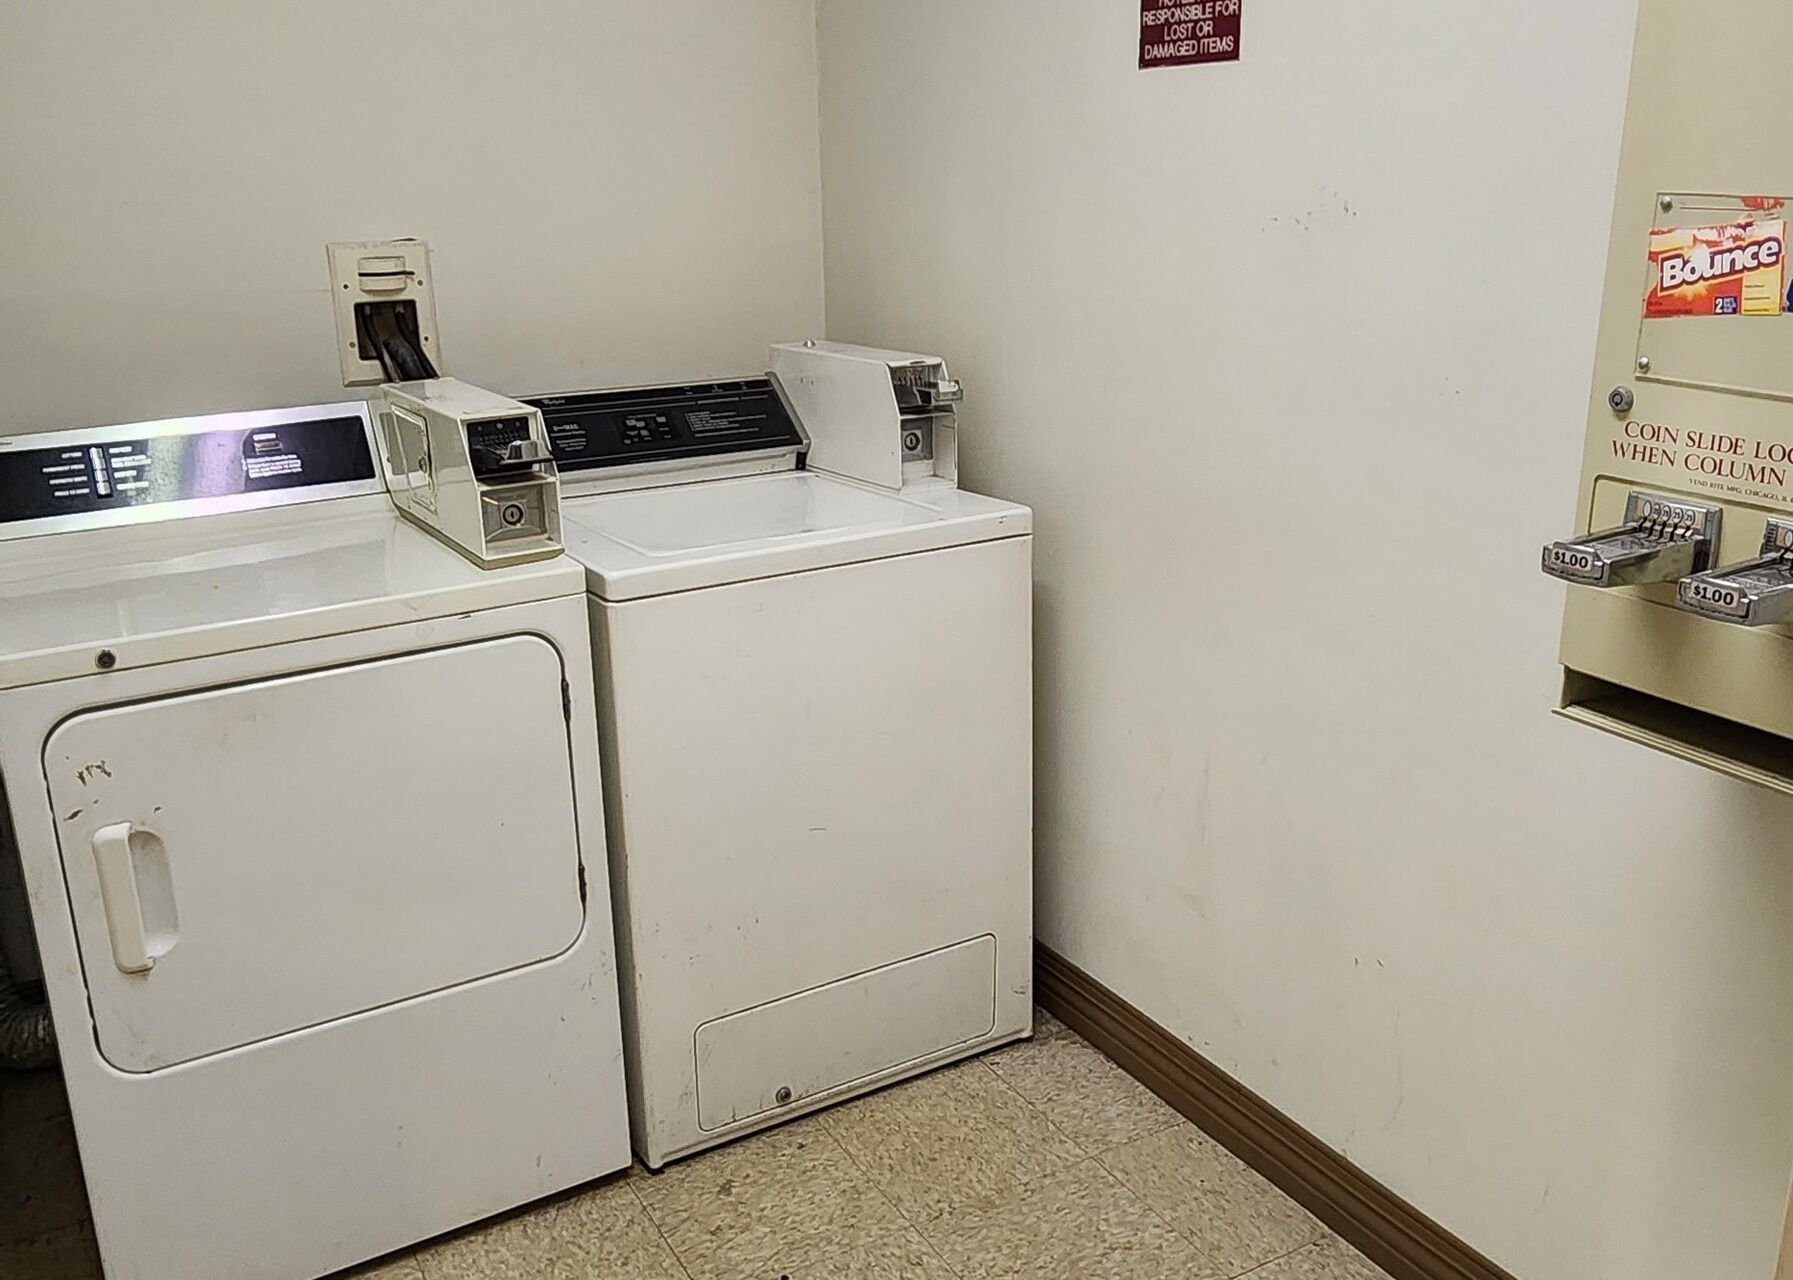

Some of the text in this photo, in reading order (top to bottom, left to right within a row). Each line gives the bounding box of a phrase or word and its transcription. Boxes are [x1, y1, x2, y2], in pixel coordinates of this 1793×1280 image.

[1142, 0, 1239, 26] RESPONSIBLE FOR
[1163, 20, 1214, 40] LOST OR
[1144, 35, 1234, 60] DAMAGED ITEMS
[1661, 239, 1779, 289] Bounce
[1714, 298, 1723, 314] 2
[1624, 420, 1680, 445] COIN
[1685, 430, 1746, 456] SLIDE
[1611, 439, 1786, 487] WHEN COLUMN
[1689, 478, 1708, 487] VEND
[1553, 550, 1589, 569] $1.00
[1692, 583, 1735, 606] $1.00
